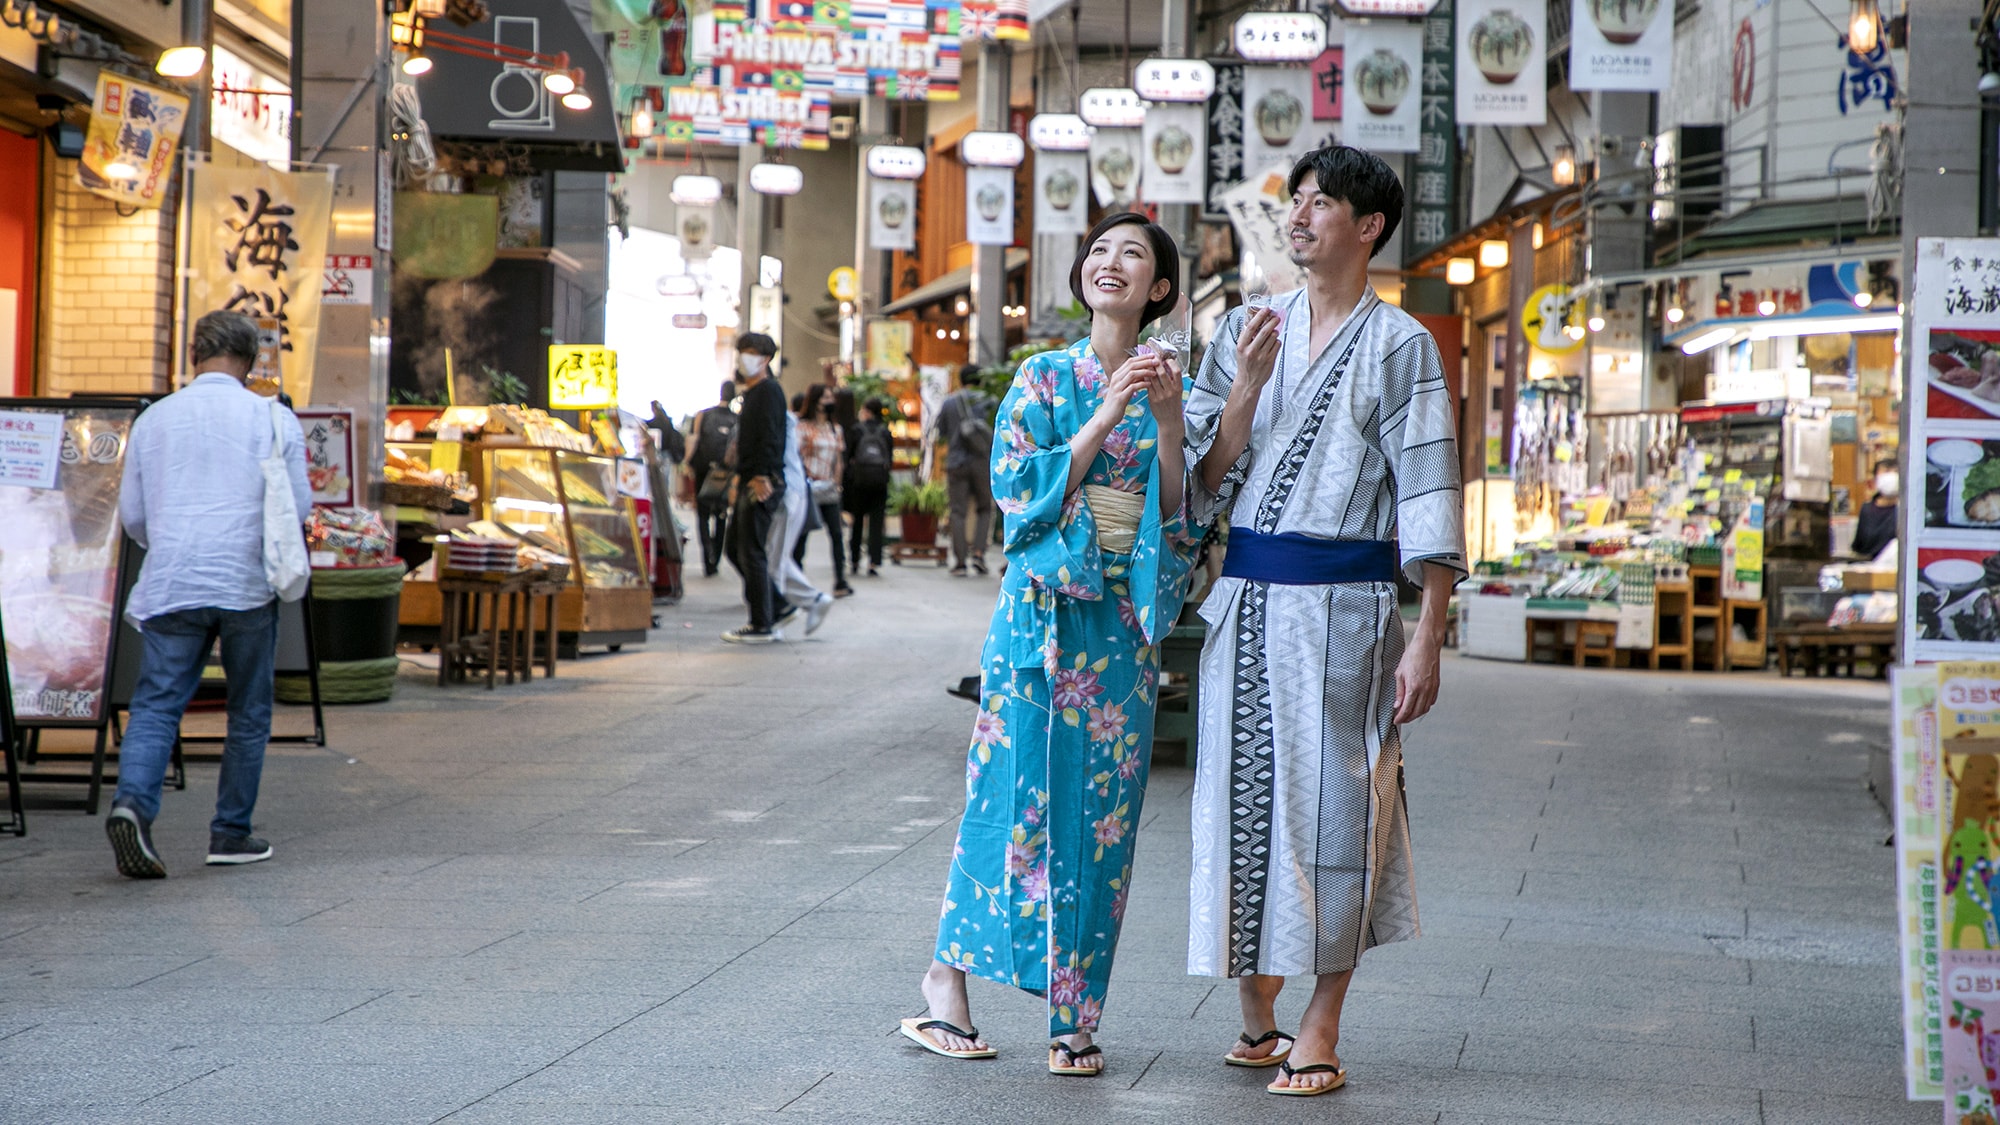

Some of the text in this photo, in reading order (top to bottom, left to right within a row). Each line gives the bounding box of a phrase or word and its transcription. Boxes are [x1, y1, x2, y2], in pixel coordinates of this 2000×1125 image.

[732, 33, 938, 69] HEIWA STREET
[723, 95, 811, 121] STREET
